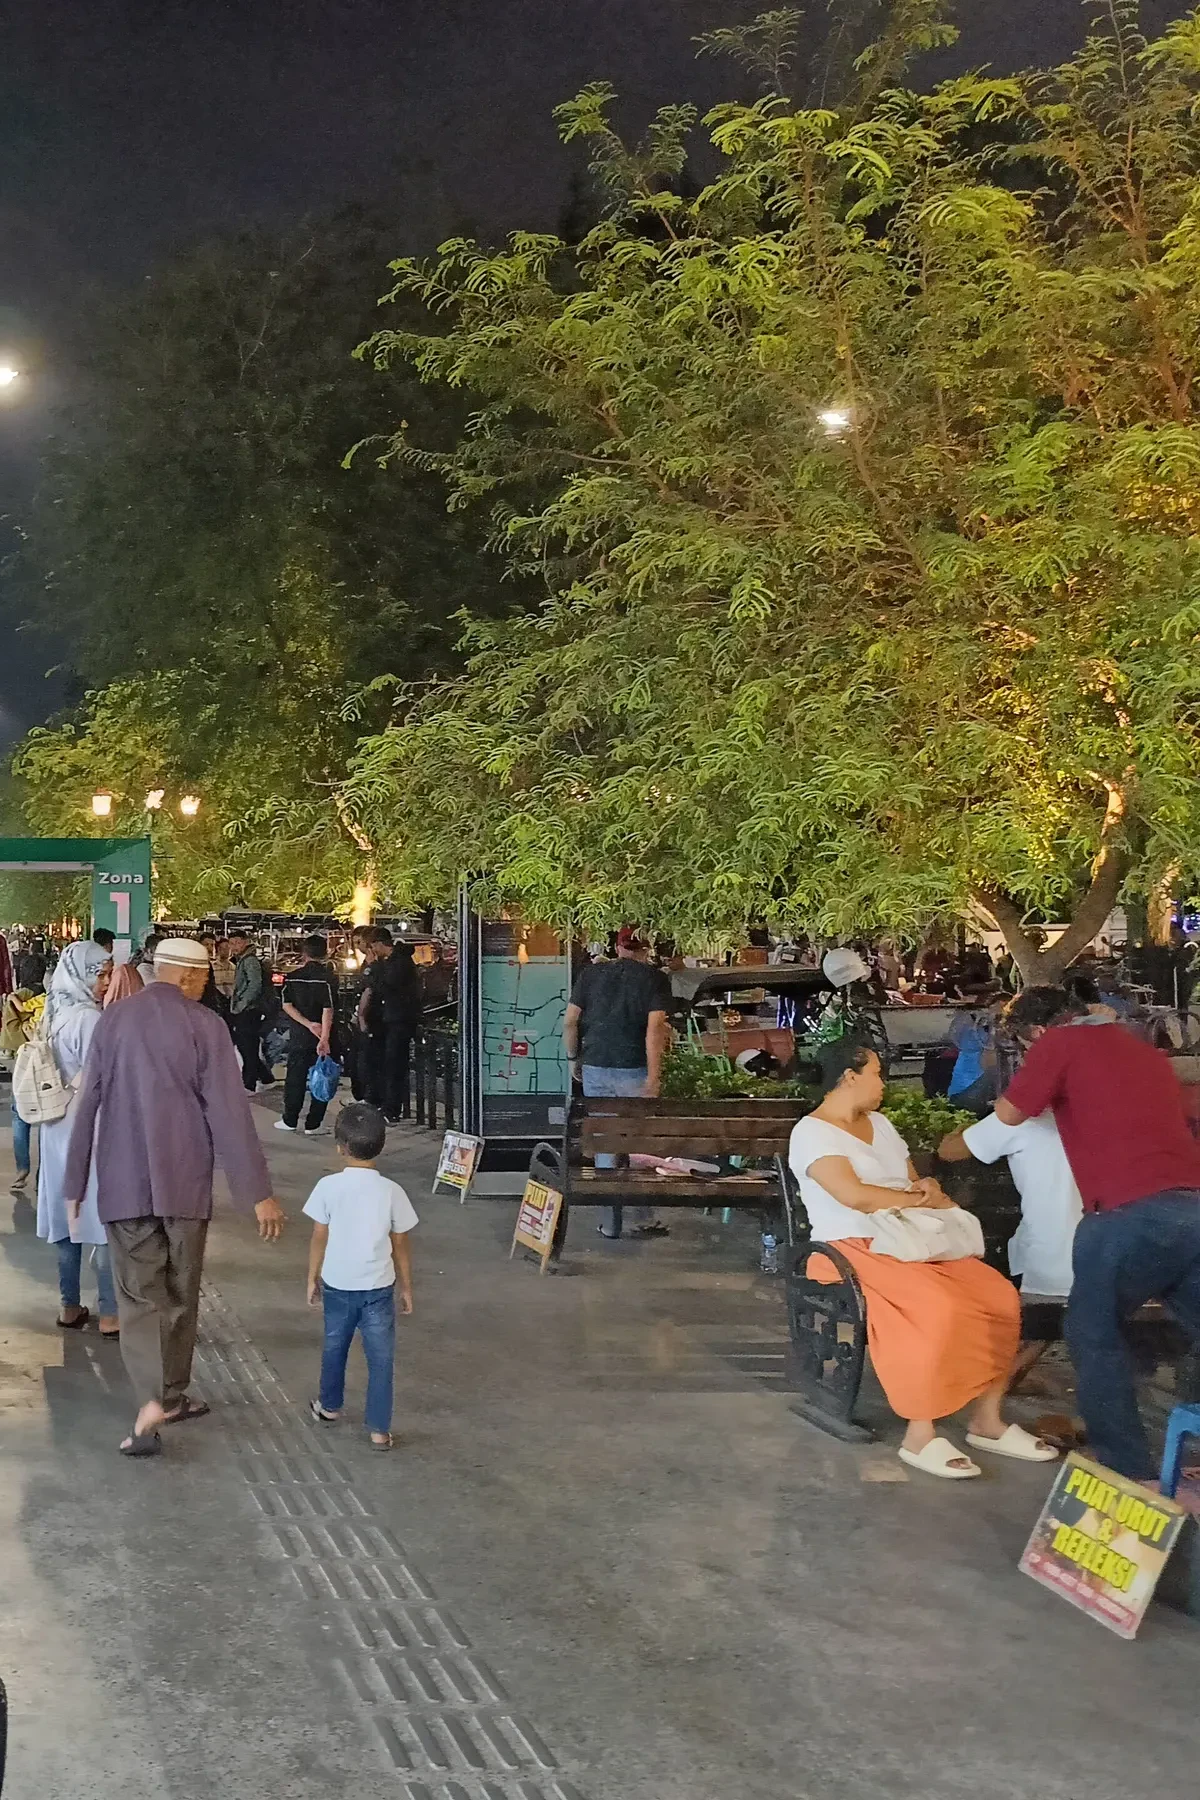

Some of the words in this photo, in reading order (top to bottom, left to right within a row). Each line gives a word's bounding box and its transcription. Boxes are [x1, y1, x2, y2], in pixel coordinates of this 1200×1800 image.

[98, 872, 144, 885] Zona
[109, 891, 131, 934] 1
[1097, 1518, 1114, 1545] &
[1116, 1494, 1171, 1542] URUT
[1051, 1523, 1138, 1593] REFLEKSI
